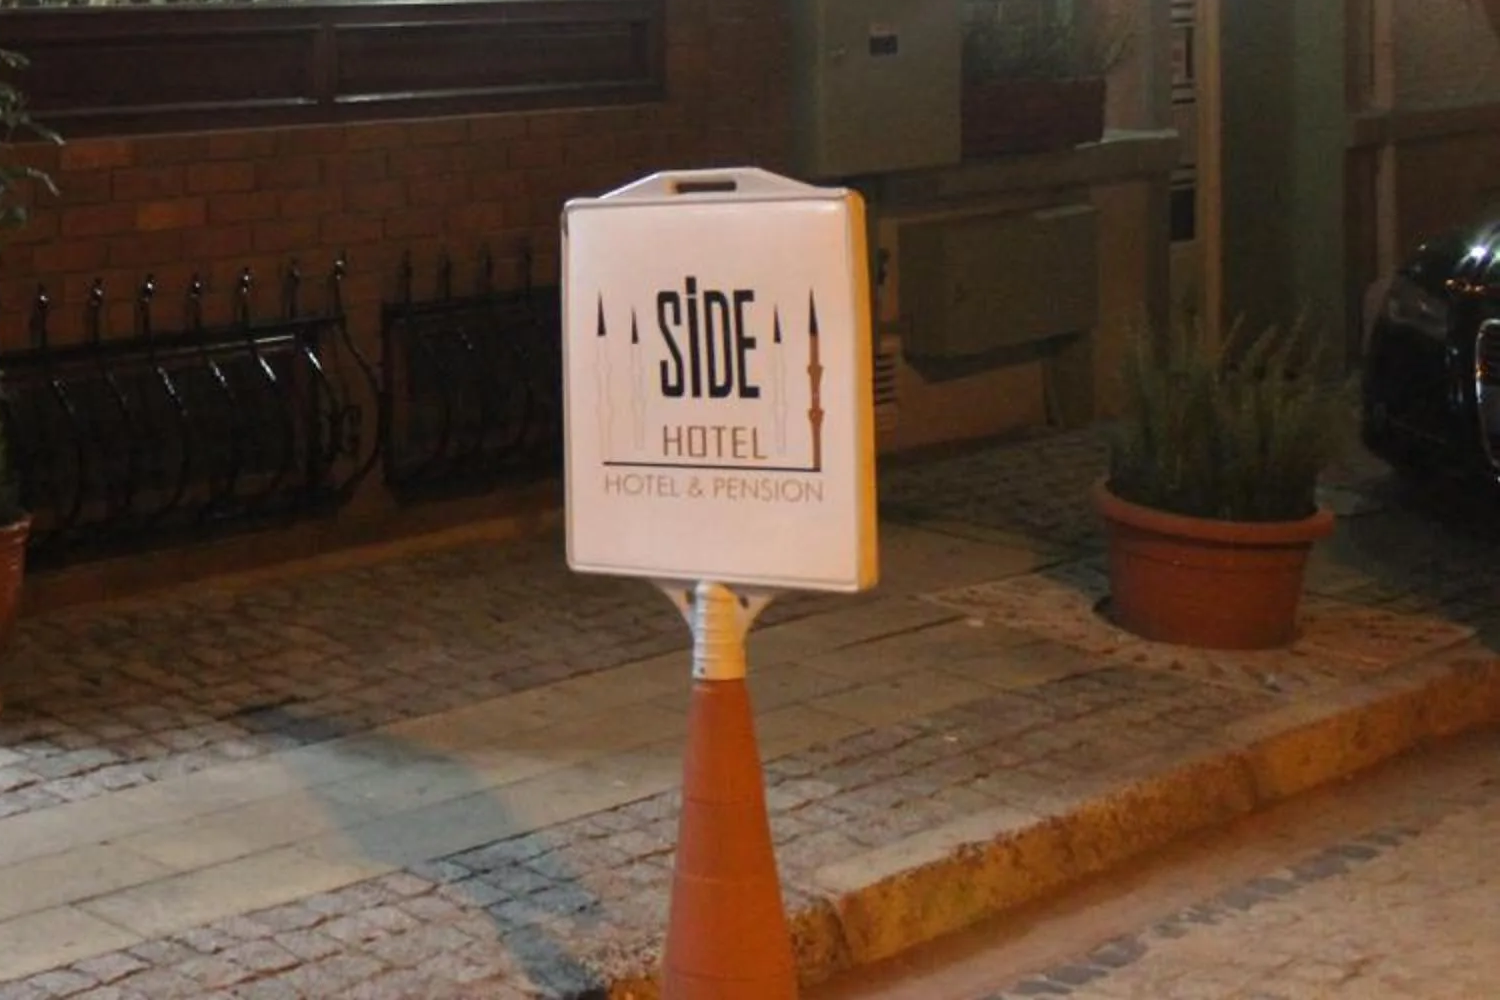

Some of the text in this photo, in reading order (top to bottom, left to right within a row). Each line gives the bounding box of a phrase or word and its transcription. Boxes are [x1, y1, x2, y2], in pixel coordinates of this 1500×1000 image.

[662, 425, 768, 460] HOTEL
[604, 474, 824, 502] HOTEL & PENSION
